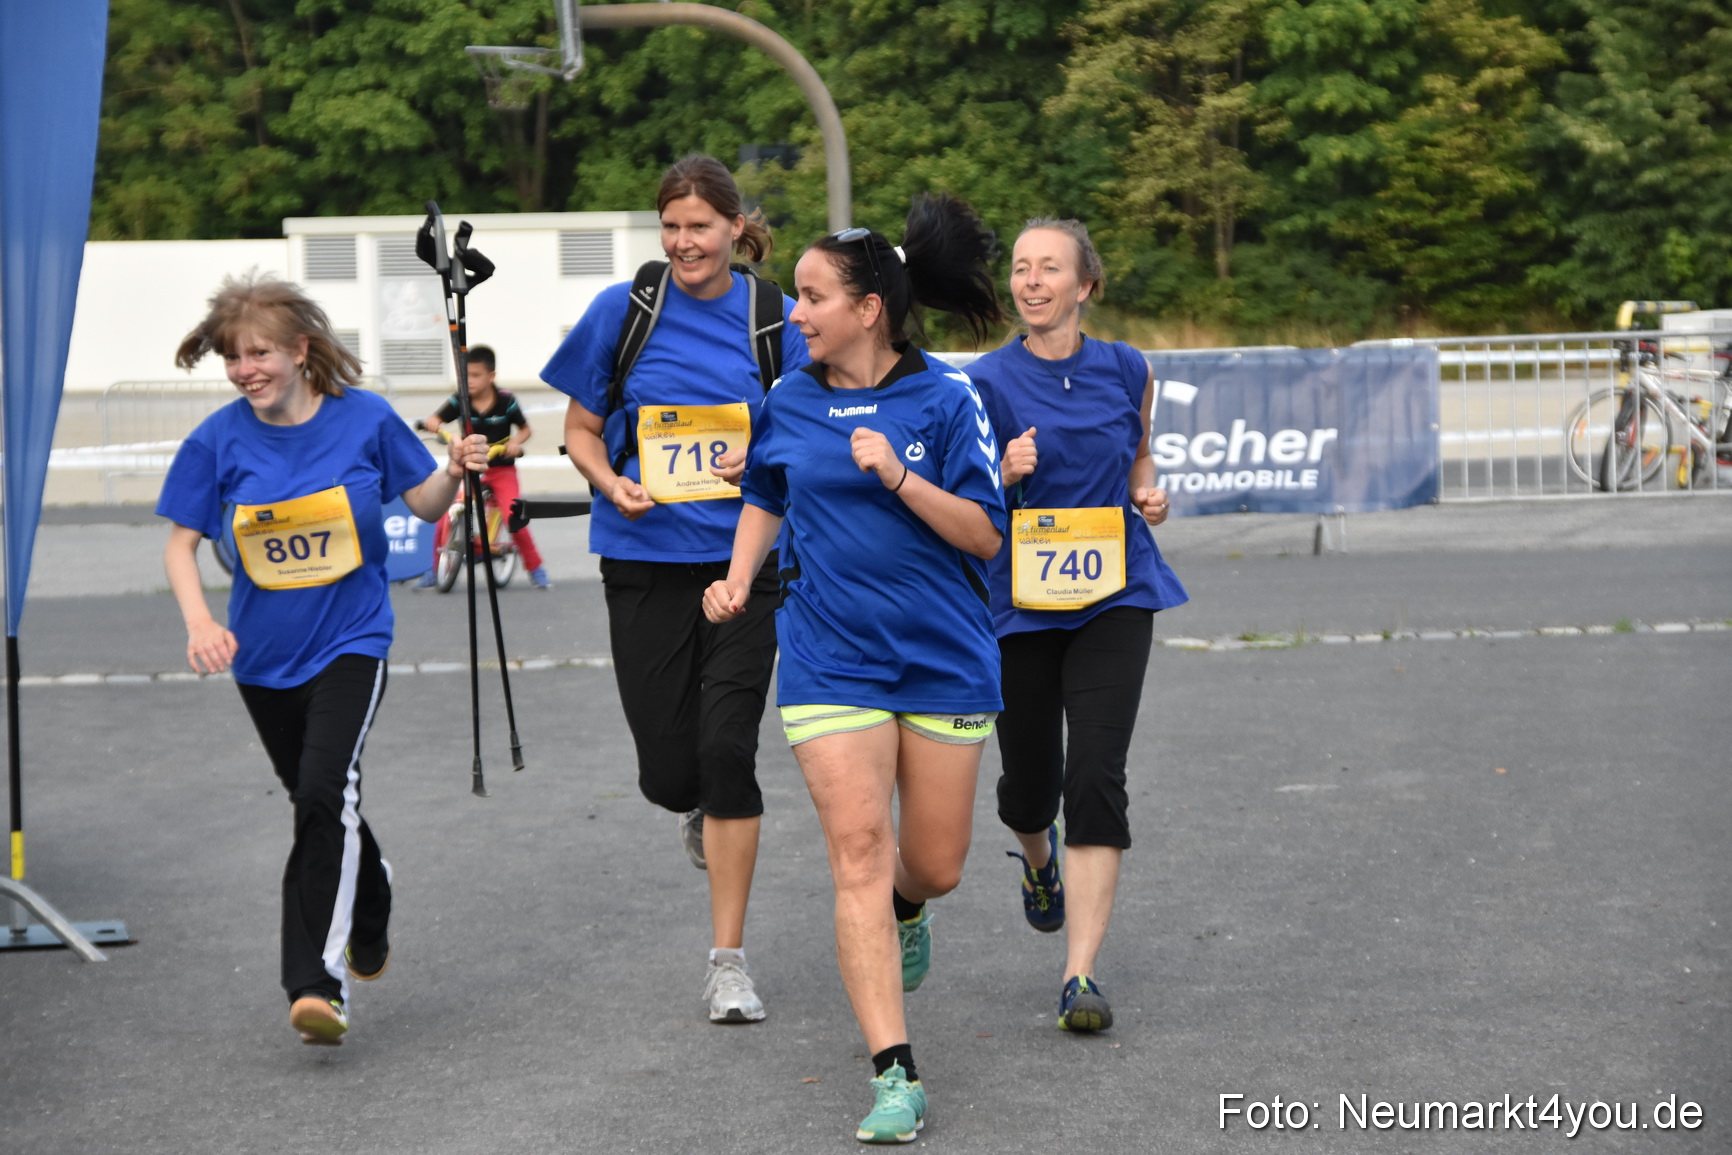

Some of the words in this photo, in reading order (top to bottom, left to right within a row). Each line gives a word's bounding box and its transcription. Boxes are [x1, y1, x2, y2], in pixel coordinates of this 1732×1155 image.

[828, 404, 877, 417] hummel
[662, 440, 728, 474] 718
[1149, 419, 1338, 467] scher
[263, 531, 331, 564] 807
[1036, 549, 1103, 581] 740
